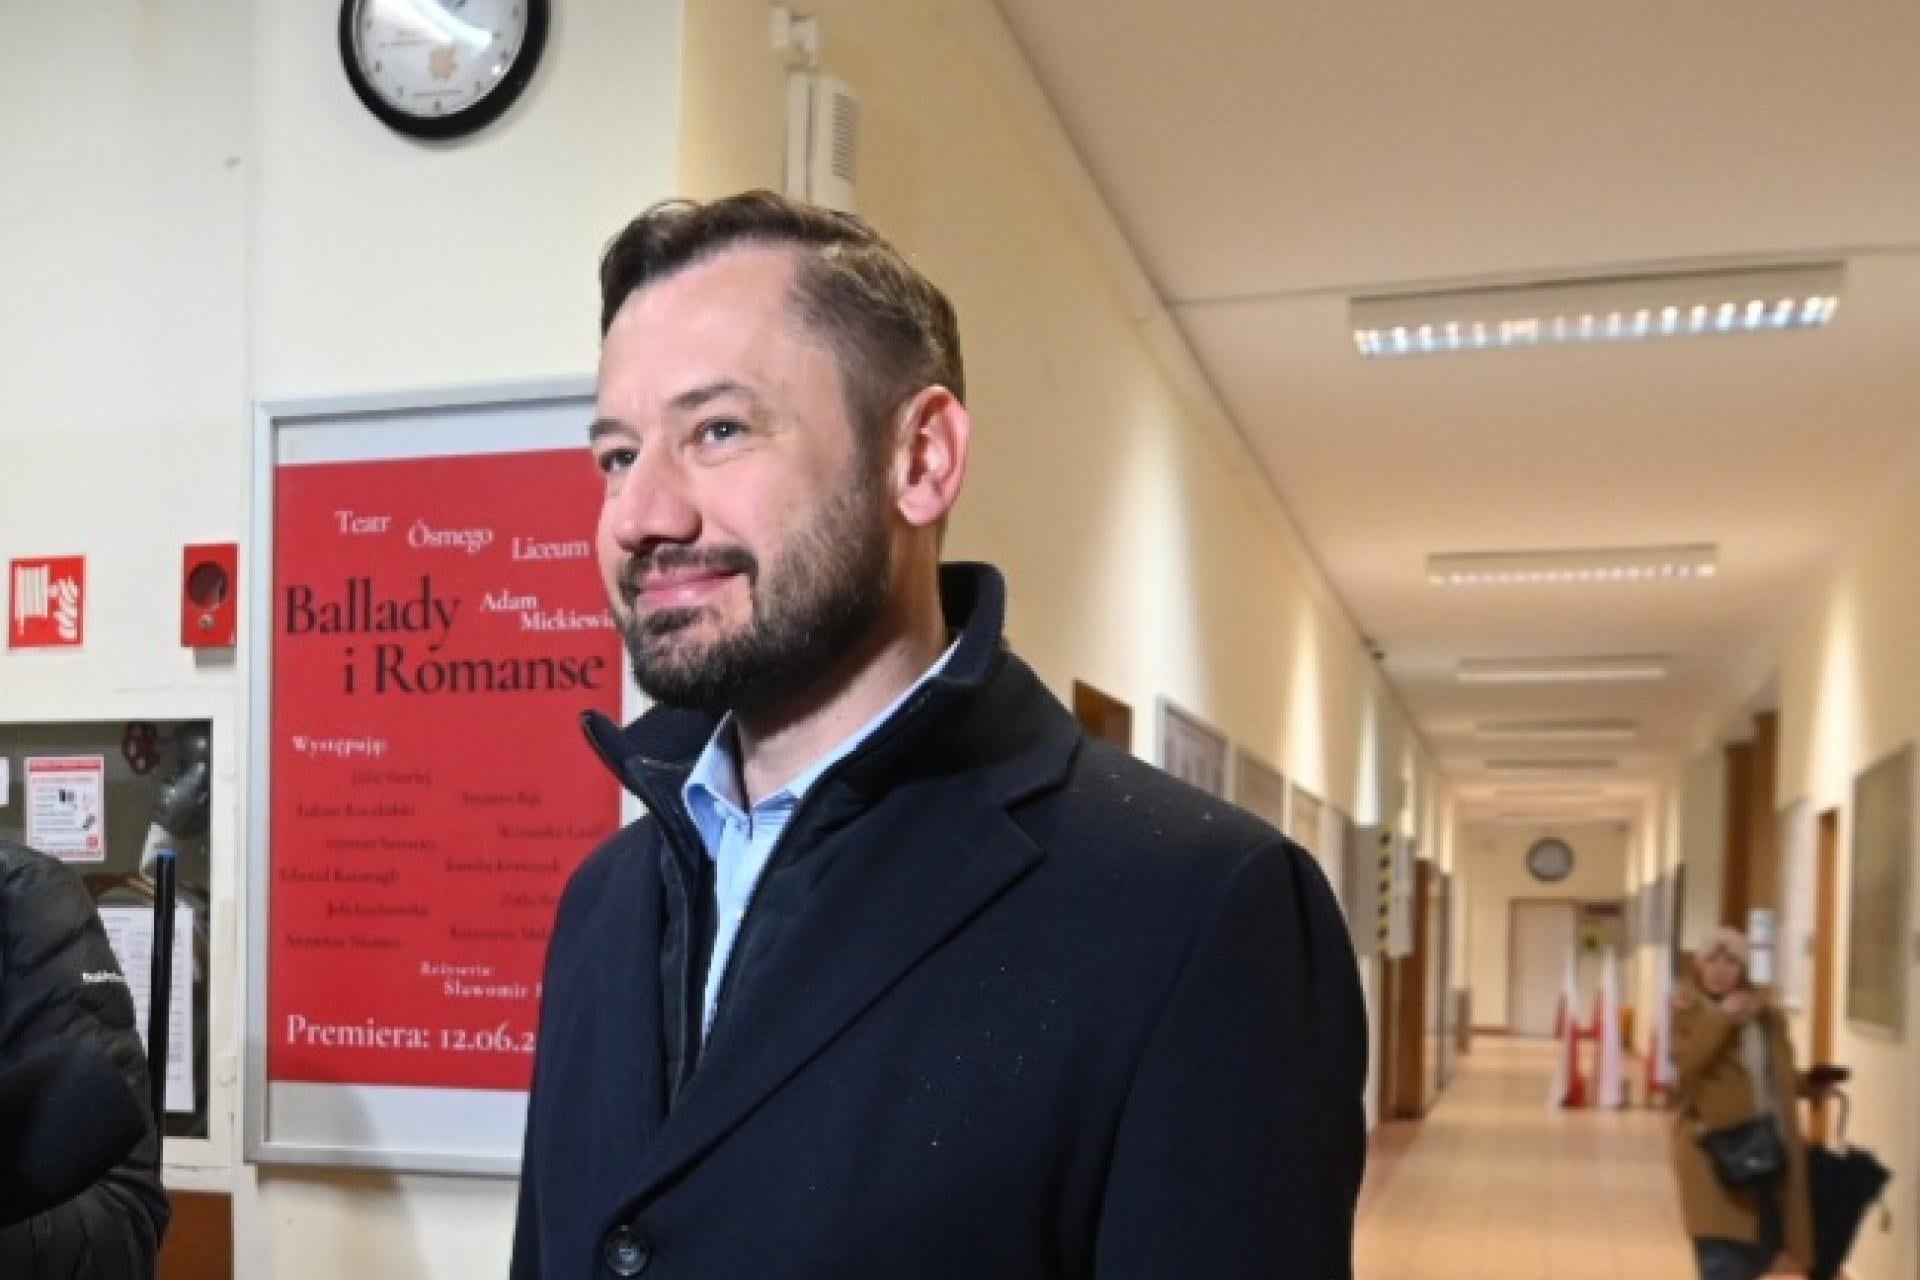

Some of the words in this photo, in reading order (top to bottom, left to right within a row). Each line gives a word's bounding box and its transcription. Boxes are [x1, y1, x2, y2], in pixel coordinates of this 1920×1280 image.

[333, 510, 392, 535] Teatr
[407, 519, 496, 555] Ósmego
[512, 536, 591, 561] Liceum
[285, 575, 461, 650] Ballady
[480, 589, 539, 612] Adam
[344, 646, 357, 695] i
[375, 644, 606, 694] Romanse
[286, 1014, 430, 1049] Premiera:
